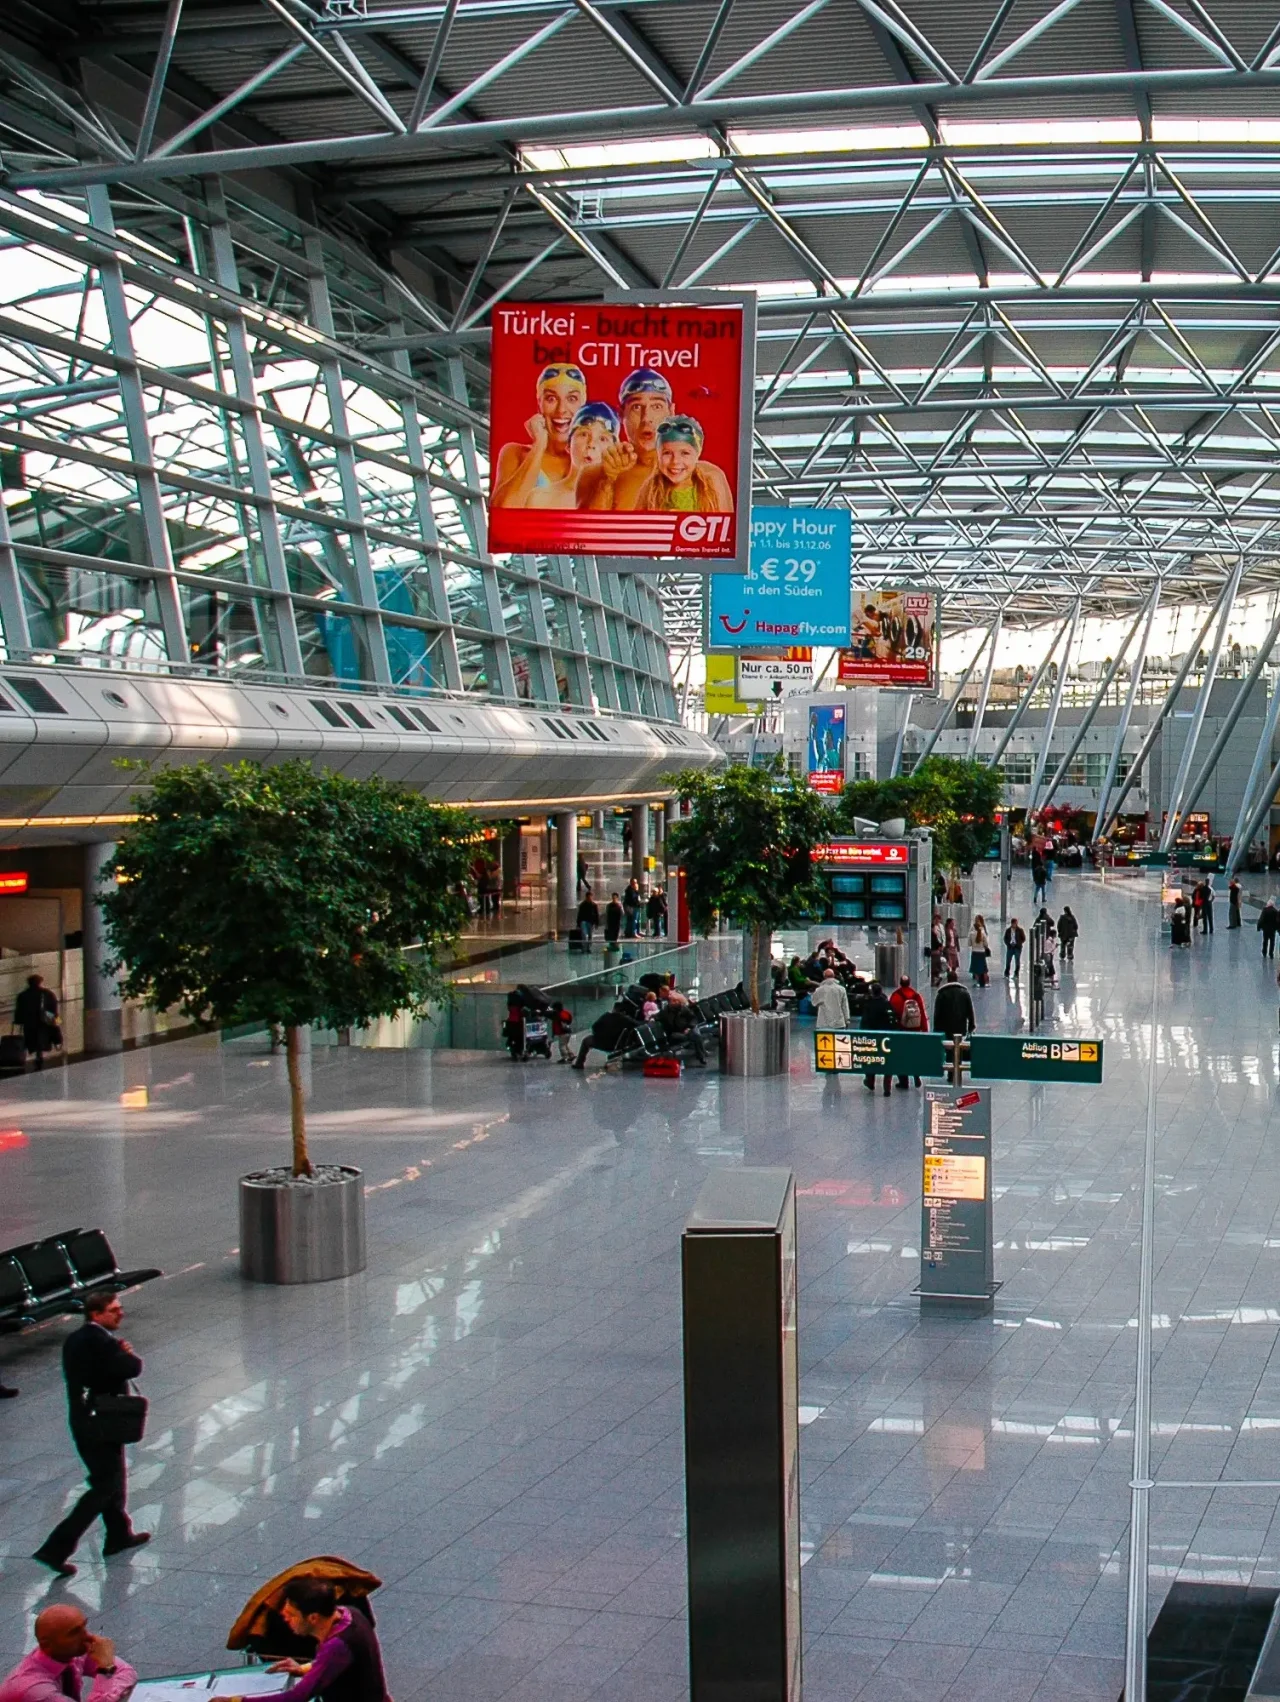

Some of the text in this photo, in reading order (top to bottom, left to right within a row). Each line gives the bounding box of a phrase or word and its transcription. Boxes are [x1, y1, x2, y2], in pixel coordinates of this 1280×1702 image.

[499, 310, 575, 336] Türkei
[596, 312, 669, 337] bucht
[677, 320, 735, 339] man
[533, 341, 699, 368] bei GTI Travel
[679, 515, 731, 542] GTI
[793, 518, 837, 535] Hour
[760, 540, 774, 549] 1.1.
[776, 540, 791, 549] bis
[793, 540, 831, 550] 31.12.06
[743, 584, 823, 597] in den Süden
[907, 598, 928, 607] LTU
[755, 620, 847, 637] Hapagfly.com
[742, 663, 813, 674] Nur ca. 50 m
[852, 1036, 891, 1053] Abflug C
[1022, 1042, 1061, 1060] Abflug B
[852, 1053, 886, 1065] Ausgang
